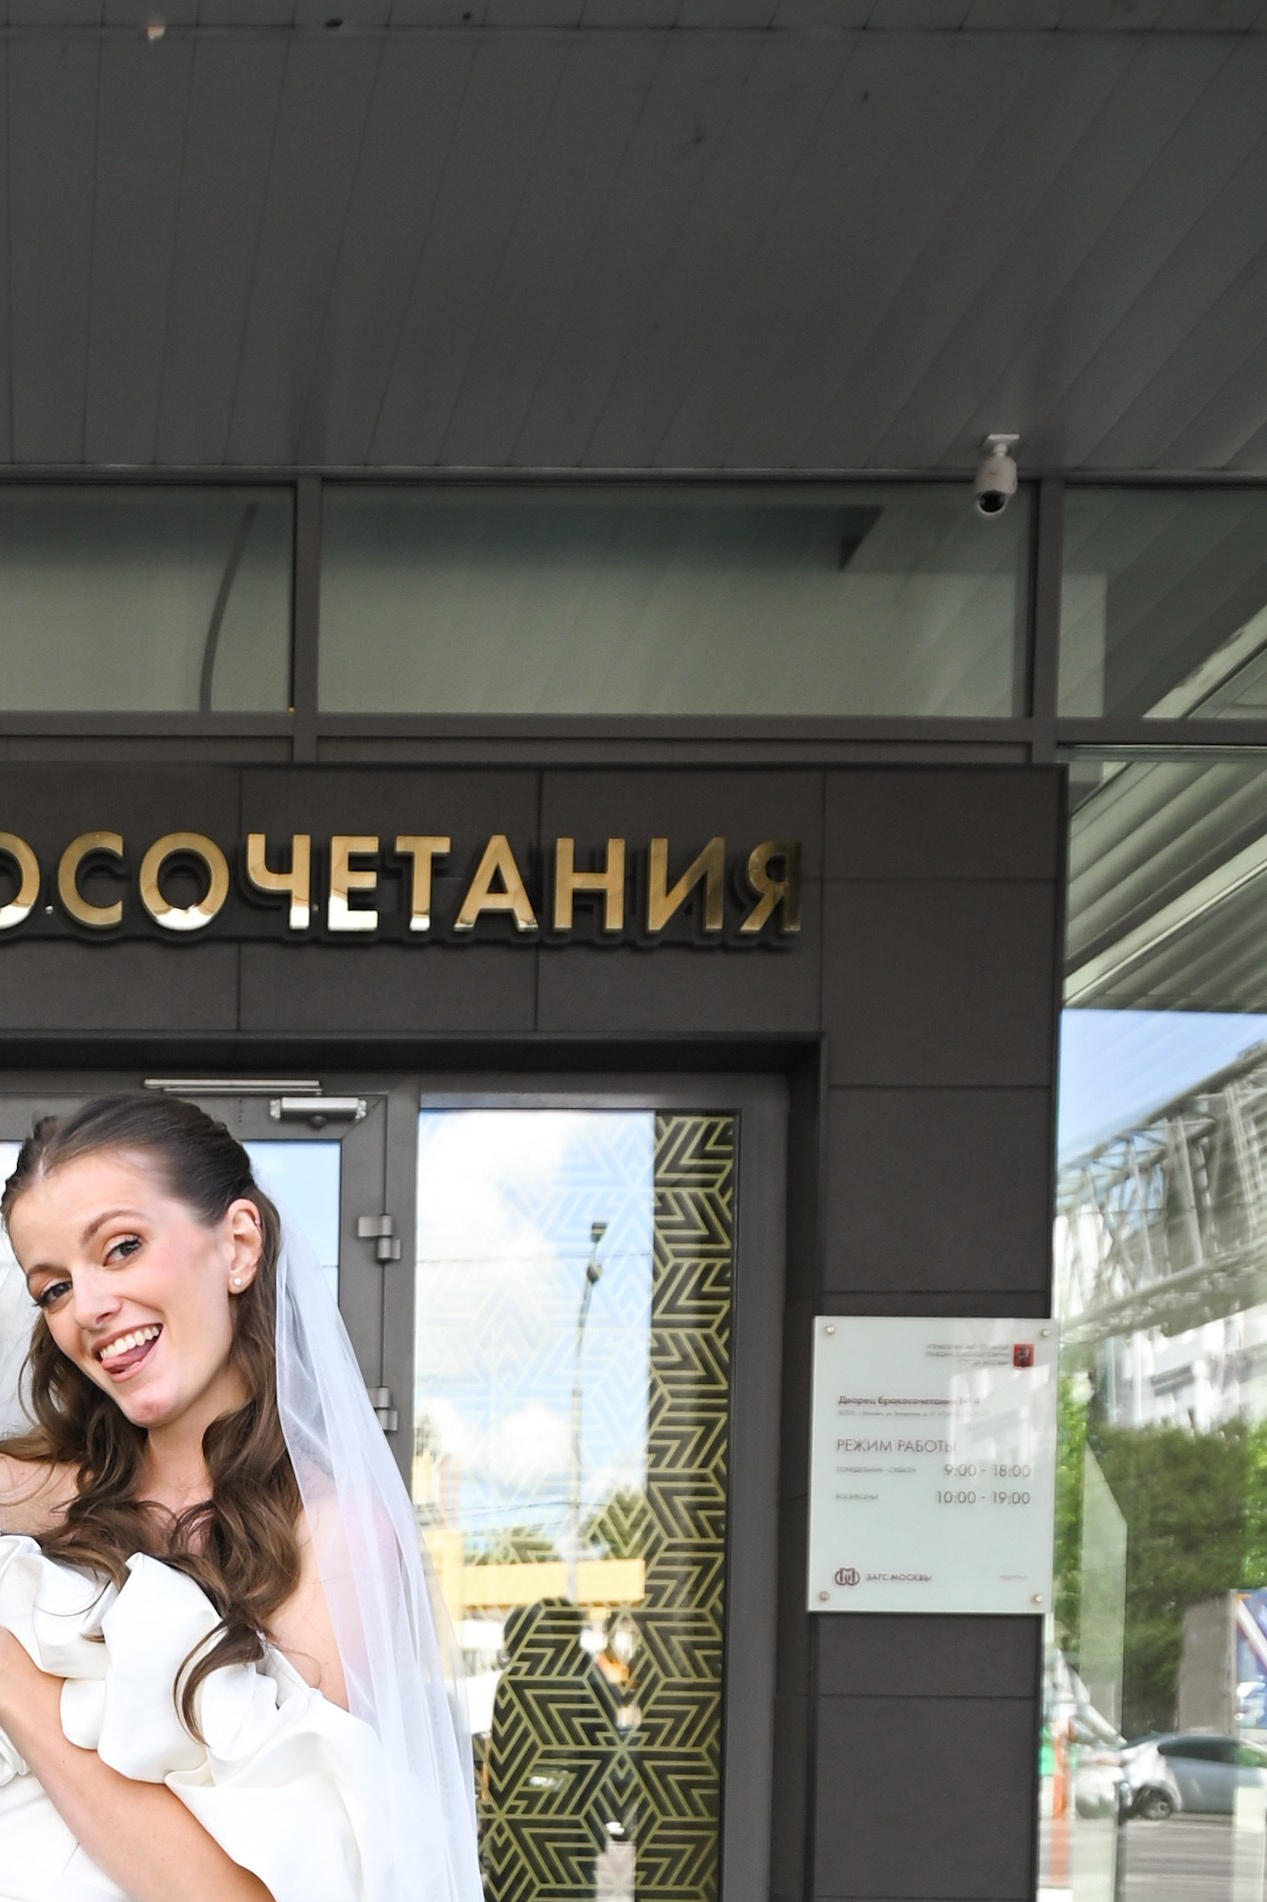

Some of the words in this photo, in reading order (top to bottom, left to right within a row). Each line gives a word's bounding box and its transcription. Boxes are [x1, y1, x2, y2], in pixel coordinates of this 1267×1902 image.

[836, 1439, 893, 1453] РЕЖИМ
[897, 1439, 956, 1454] РАБОТЫ
[944, 1463, 977, 1477] 9:00
[992, 1464, 1031, 1478] 18:00
[936, 1490, 977, 1504] 10:00
[991, 1490, 1031, 1505] 19:00
